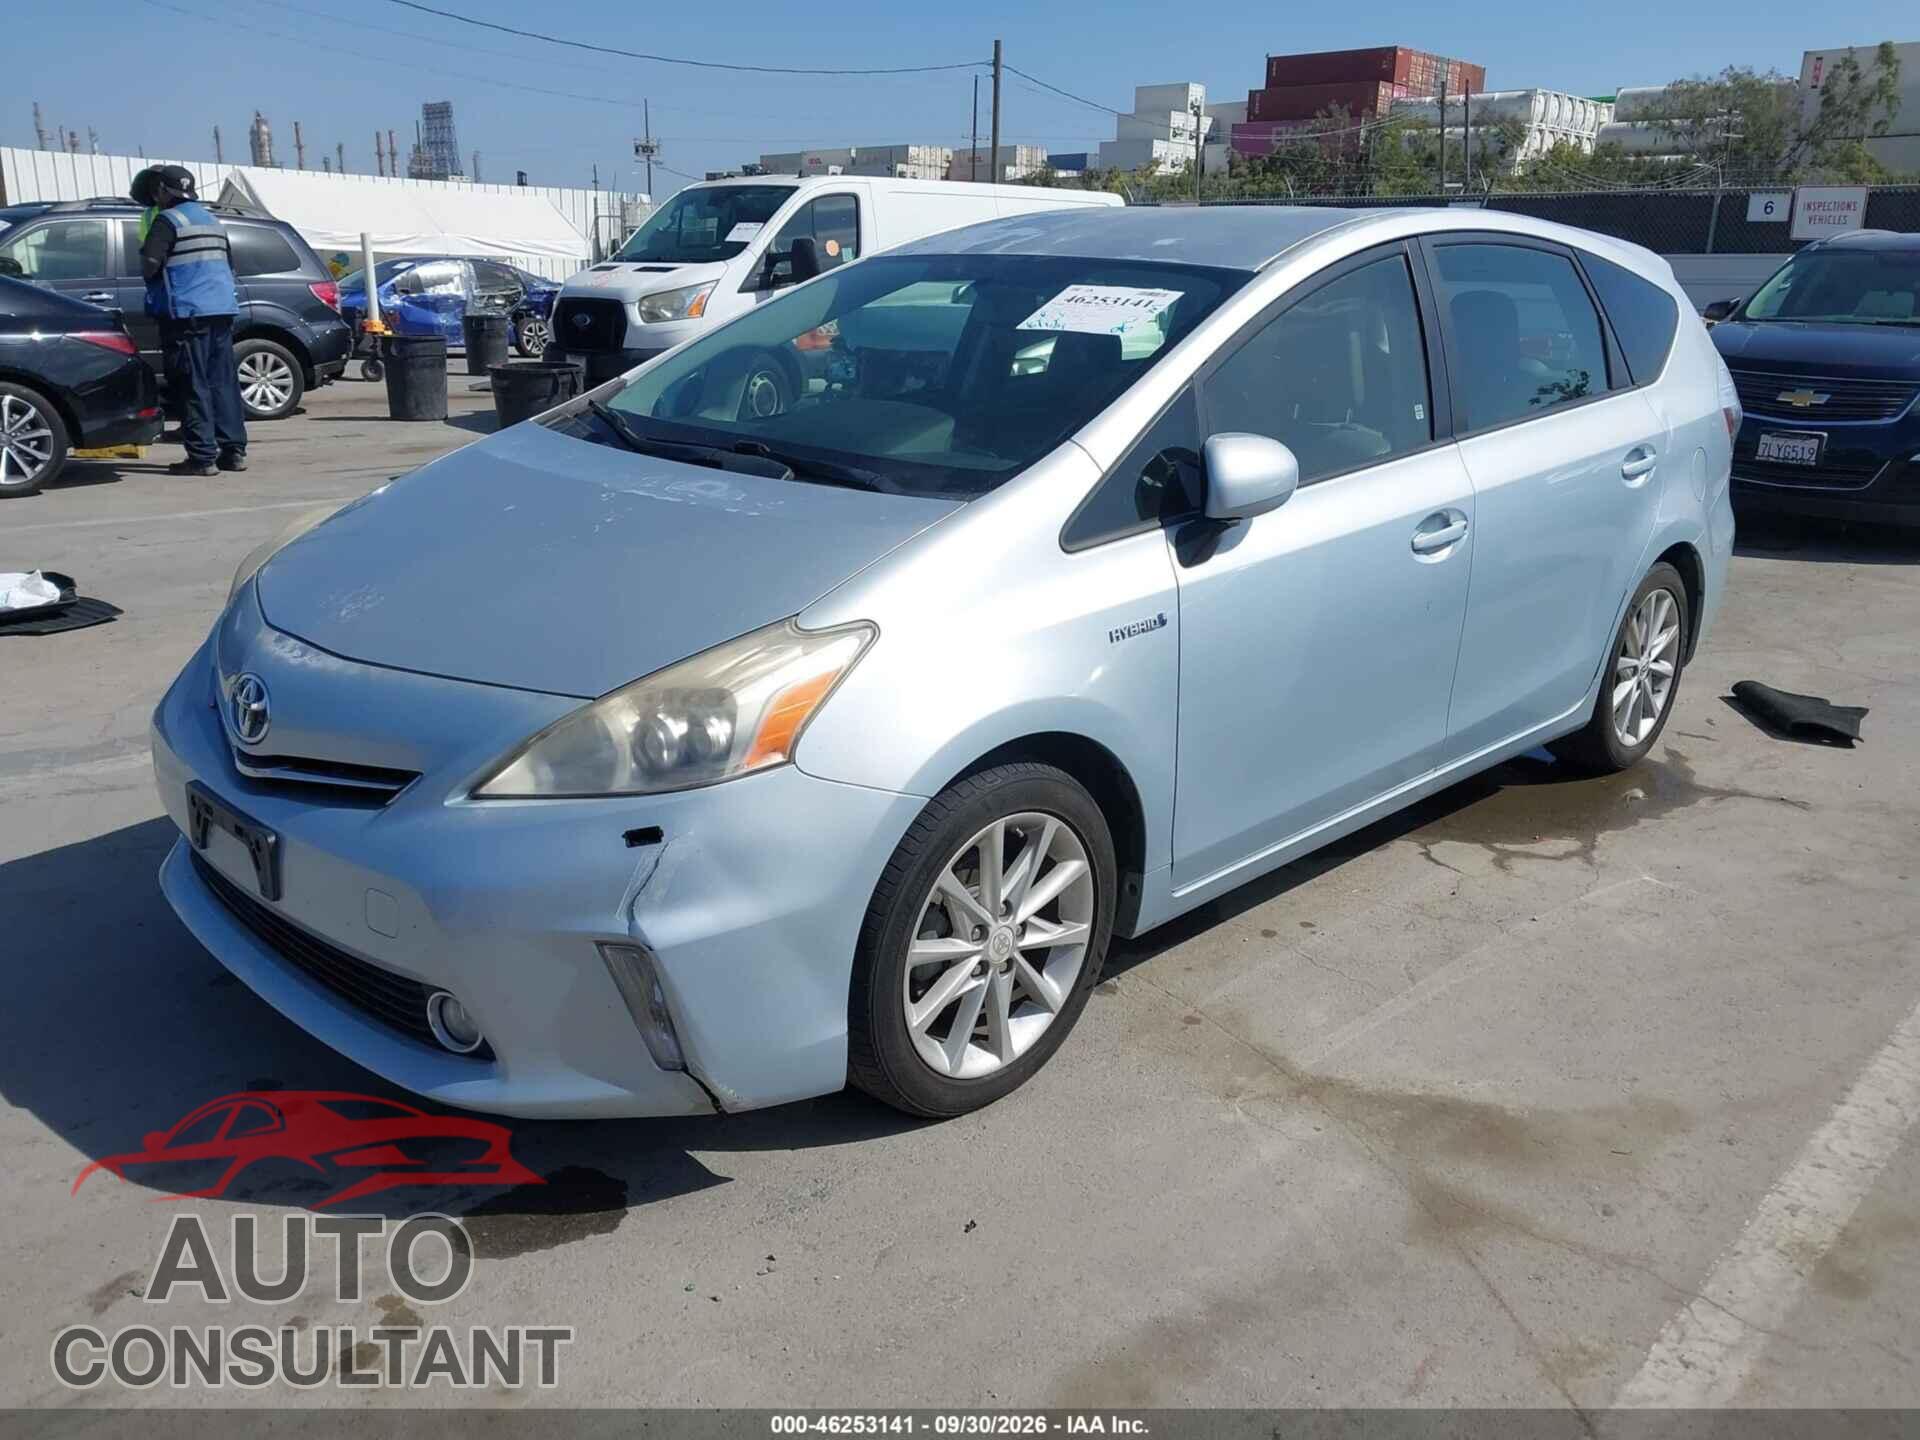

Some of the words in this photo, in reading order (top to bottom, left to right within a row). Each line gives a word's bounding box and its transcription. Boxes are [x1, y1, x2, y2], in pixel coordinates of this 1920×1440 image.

[1763, 200, 1776, 216] 6
[1802, 200, 1858, 212] INSPECTIONS
[1807, 214, 1849, 225] VEHICLES
[1064, 294, 1155, 309] 46253141
[1107, 614, 1160, 644] HYBRID
